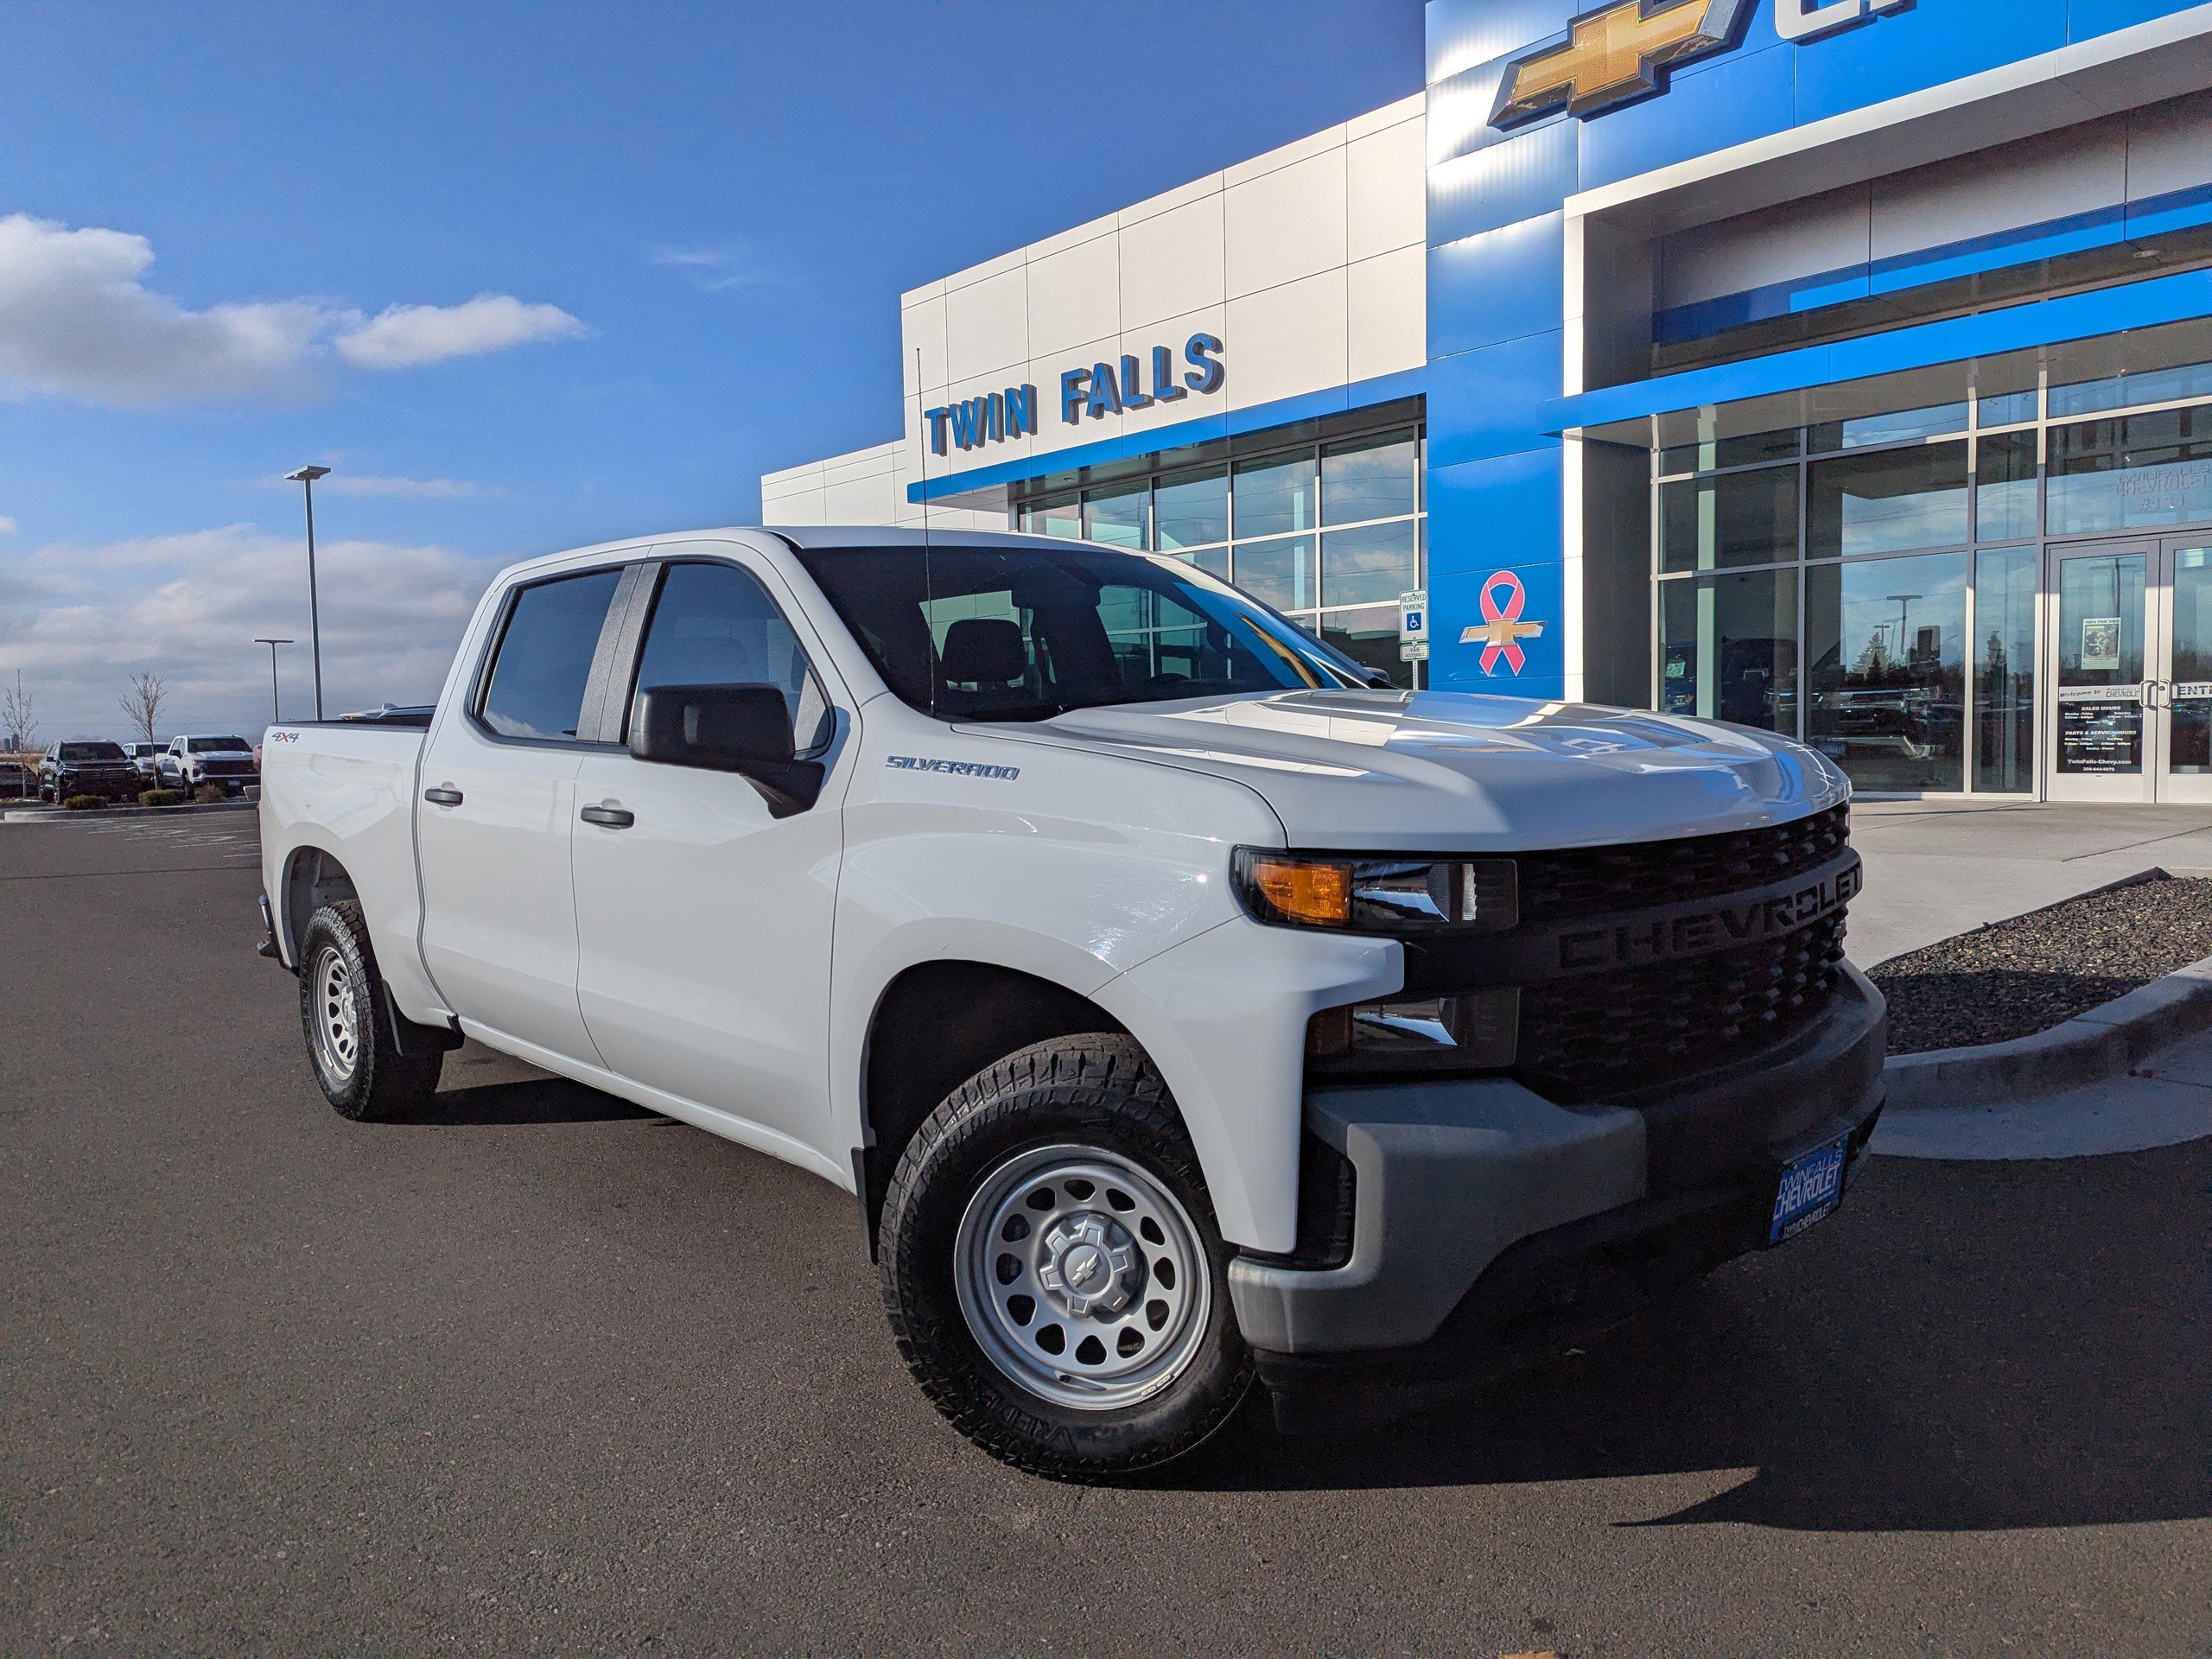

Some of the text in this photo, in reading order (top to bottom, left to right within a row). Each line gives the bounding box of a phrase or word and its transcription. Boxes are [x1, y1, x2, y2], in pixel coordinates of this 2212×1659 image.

[925, 333, 1226, 457] TWIN FALLS
[1402, 594, 1426, 602] RESERVED
[886, 755, 1020, 781] SILVERADO
[1558, 861, 1861, 970] CHEVROLET
[1773, 1164, 1840, 1220] CHEVROLET
